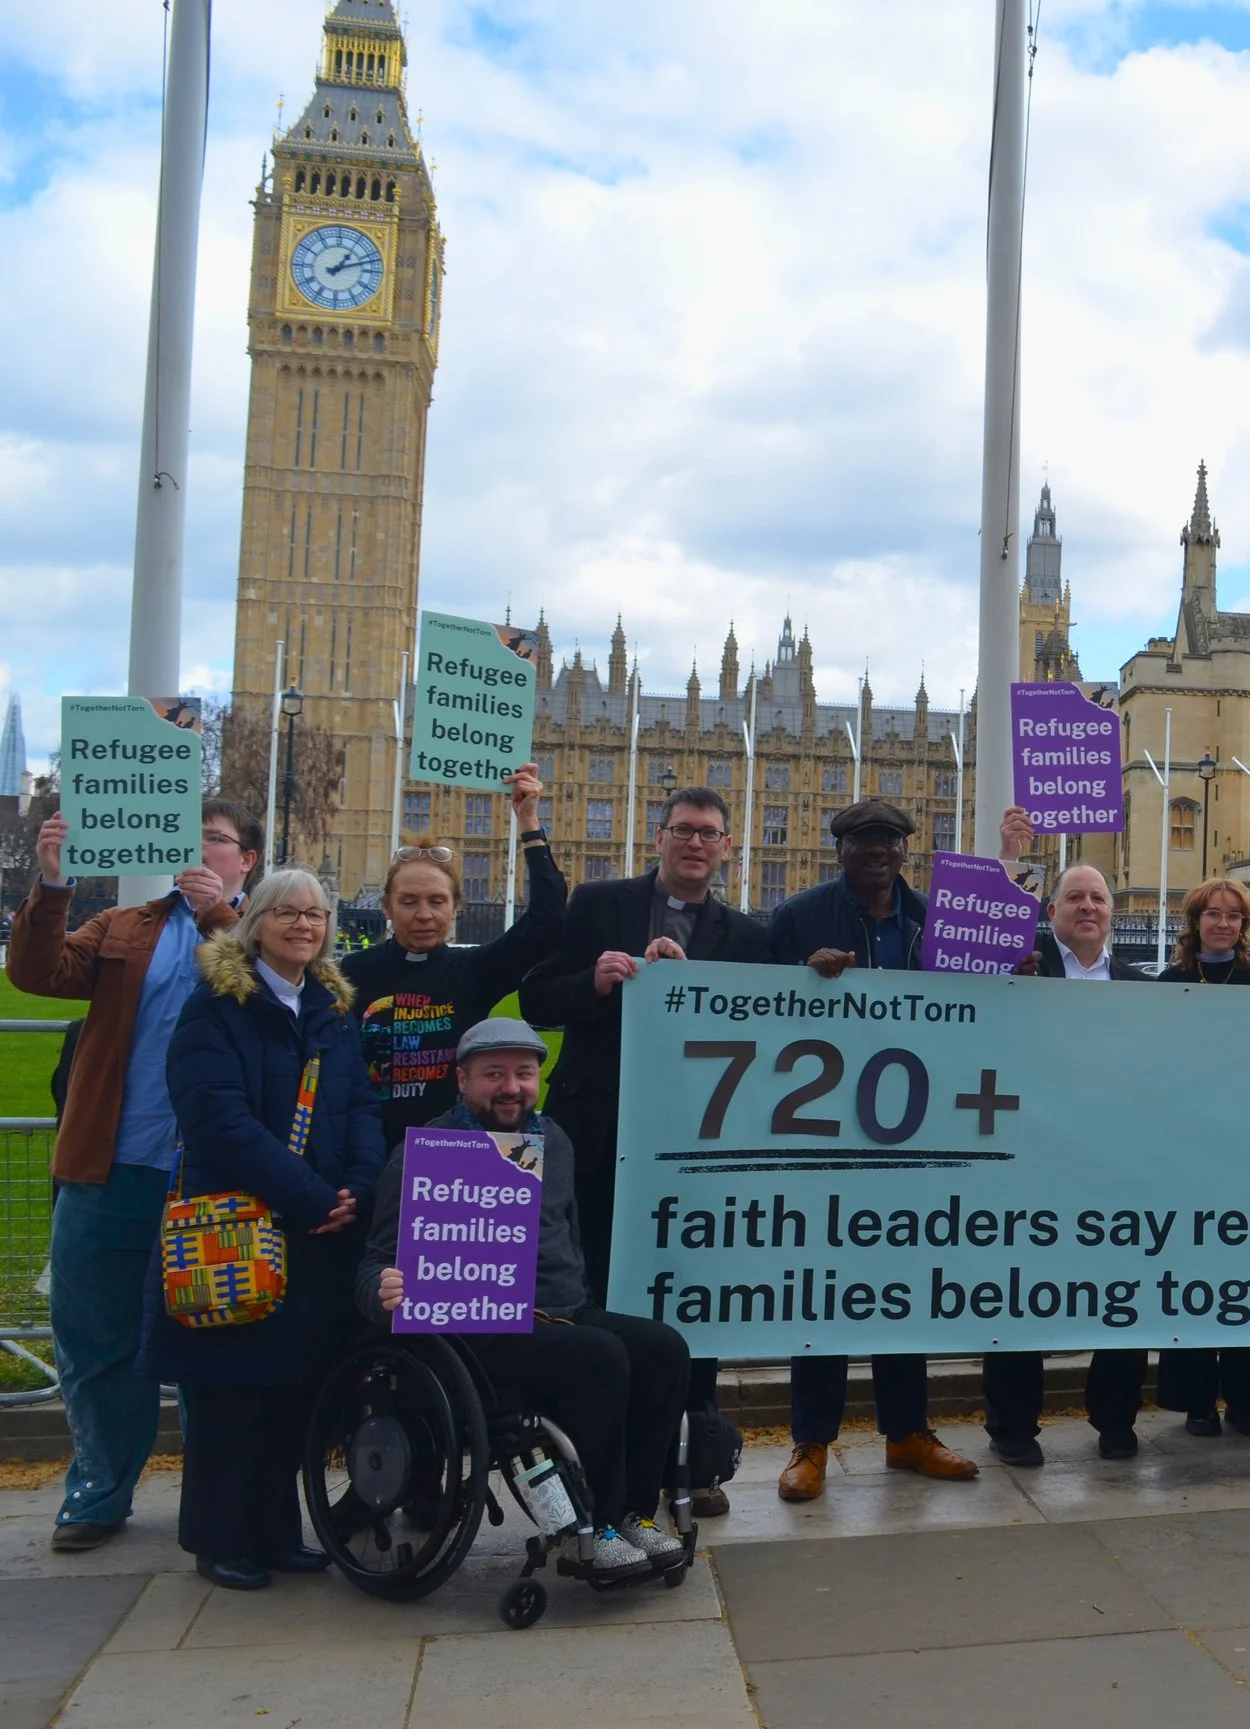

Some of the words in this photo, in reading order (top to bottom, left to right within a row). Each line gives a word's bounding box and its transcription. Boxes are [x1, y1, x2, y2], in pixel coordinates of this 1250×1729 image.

[428, 619, 492, 637] #TogetherNotTorn
[427, 652, 527, 687] Refugee
[69, 704, 145, 713] #TogetherNotTorn
[426, 685, 523, 719] families
[432, 718, 515, 753] belong
[1019, 718, 1112, 740] Refugee
[71, 738, 191, 764] Refugee
[1021, 747, 1112, 766] families
[417, 751, 520, 780] togethe
[72, 773, 188, 794] families
[1029, 776, 1106, 798] belong
[81, 808, 181, 833] belong
[66, 842, 194, 869] together
[935, 888, 1031, 919] Refugee
[934, 919, 1025, 948] families
[393, 1001, 456, 1020] INJUSTICE
[664, 985, 976, 1022] #TogetherNotTorn
[393, 1017, 452, 1034] BECOMES
[393, 1035, 420, 1050] LAW
[392, 1047, 457, 1066] RESISTAN
[392, 1064, 450, 1082] BECOMES
[392, 1082, 427, 1098] DUTY
[414, 1137, 490, 1149] #TogetherNotTorn
[412, 1176, 532, 1209] Refugee
[411, 1216, 527, 1243] families
[651, 1194, 806, 1249] faith
[827, 1194, 1059, 1247] leaders
[1075, 1209, 1178, 1256] say
[417, 1255, 517, 1286] belong
[647, 1267, 912, 1323] families
[930, 1267, 1141, 1328] belong
[401, 1296, 528, 1326] together
